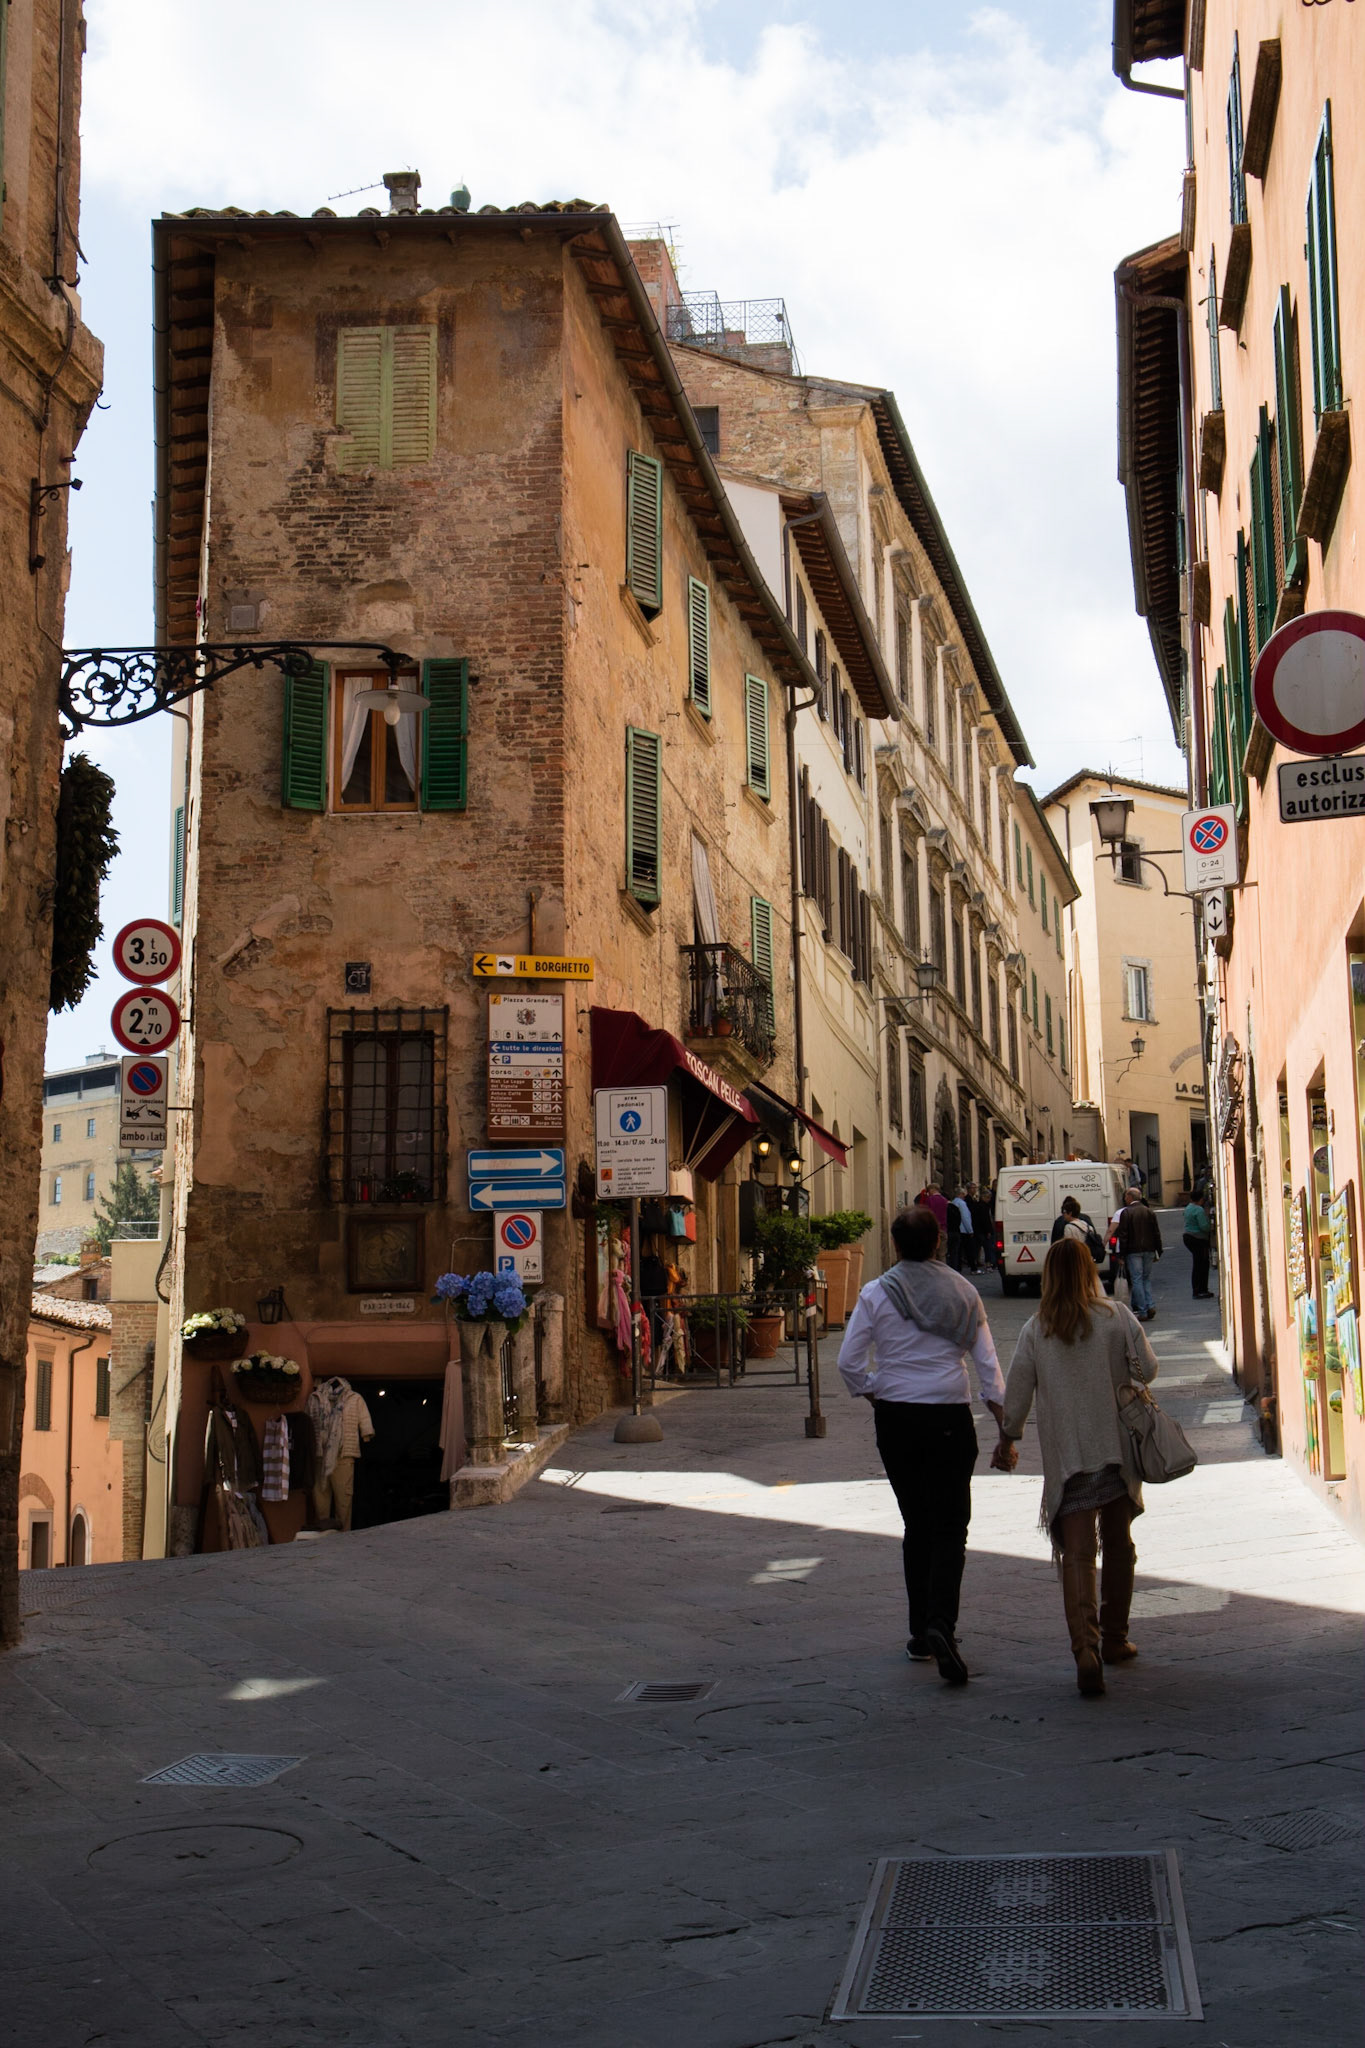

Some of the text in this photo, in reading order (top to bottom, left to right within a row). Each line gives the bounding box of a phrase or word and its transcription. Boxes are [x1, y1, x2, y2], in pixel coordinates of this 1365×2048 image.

[1296, 763, 1365, 787] esclus
[151, 938, 156, 949] t
[129, 937, 167, 965] 3.50
[519, 961, 590, 973] IL BORGHETTO
[148, 1007, 158, 1015] m
[129, 1008, 162, 1035] 2.70
[685, 1051, 744, 1112] TOSCAN PELLE
[1175, 1083, 1188, 1092] LA
[121, 1131, 145, 1141] ambo
[150, 1131, 166, 1141] lati
